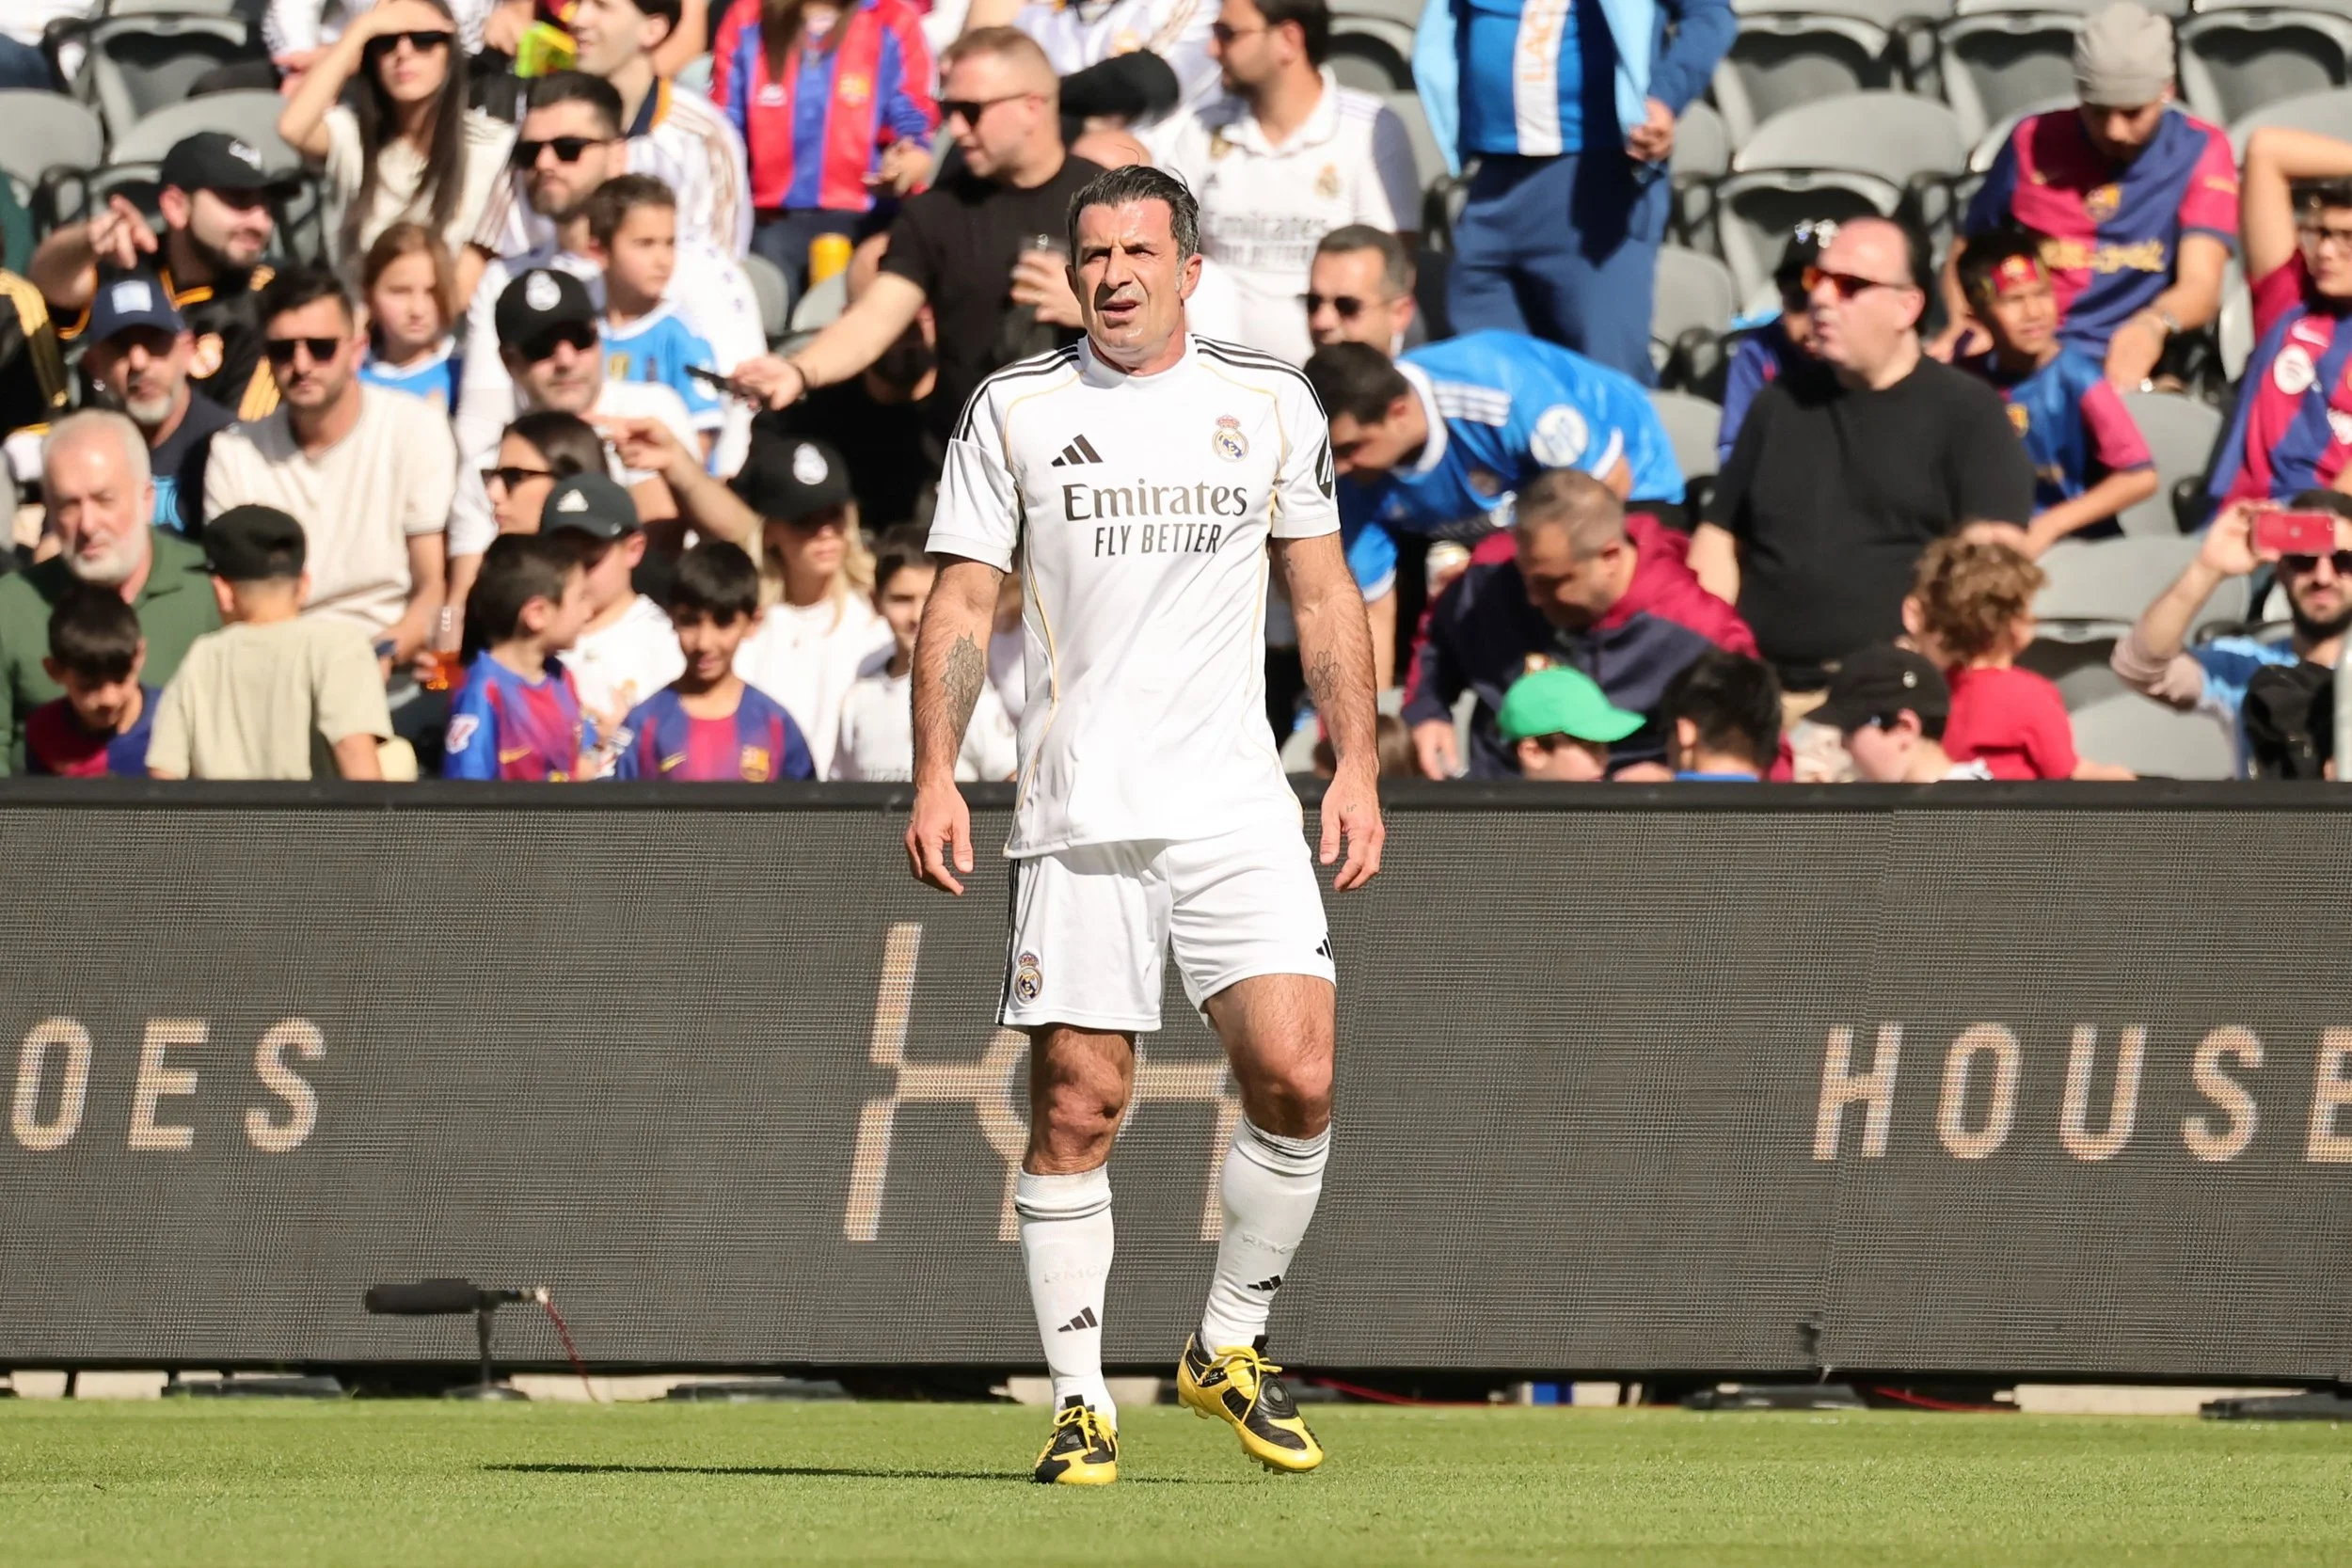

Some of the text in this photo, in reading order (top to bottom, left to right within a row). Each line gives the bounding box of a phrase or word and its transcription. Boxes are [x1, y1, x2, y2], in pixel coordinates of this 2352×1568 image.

[1062, 478, 1248, 521] Emirates
[1094, 523, 1222, 558] FLY BETTER
[11, 1016, 327, 1153] OES
[1813, 1021, 2352, 1163] HOUSE
